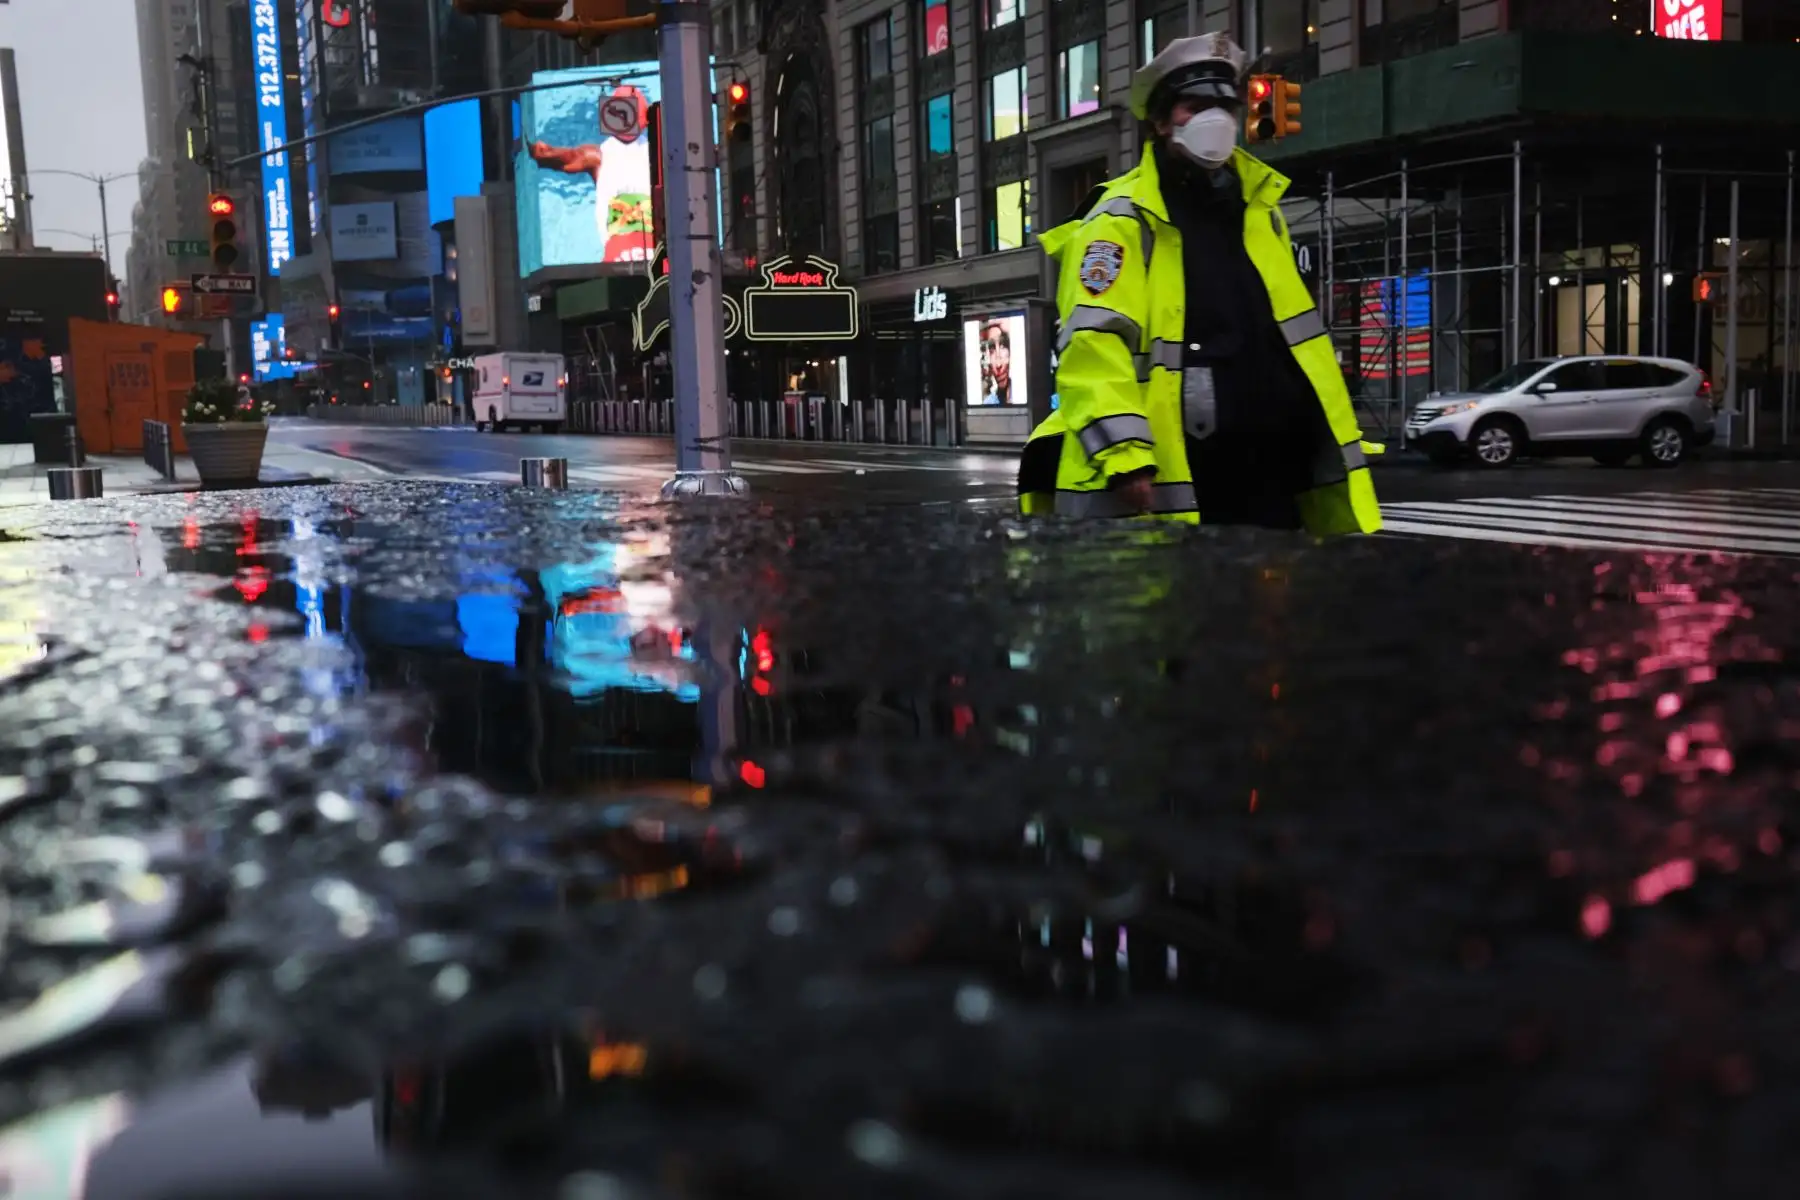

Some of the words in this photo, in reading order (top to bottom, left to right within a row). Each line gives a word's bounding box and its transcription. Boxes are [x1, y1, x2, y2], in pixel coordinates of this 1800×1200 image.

[255, 0, 280, 106] 212.372.23
[201, 279, 218, 290] ONE
[228, 279, 248, 290] WAY
[774, 271, 799, 284] Hard
[799, 272, 823, 287] Rock
[914, 285, 947, 322] Lids
